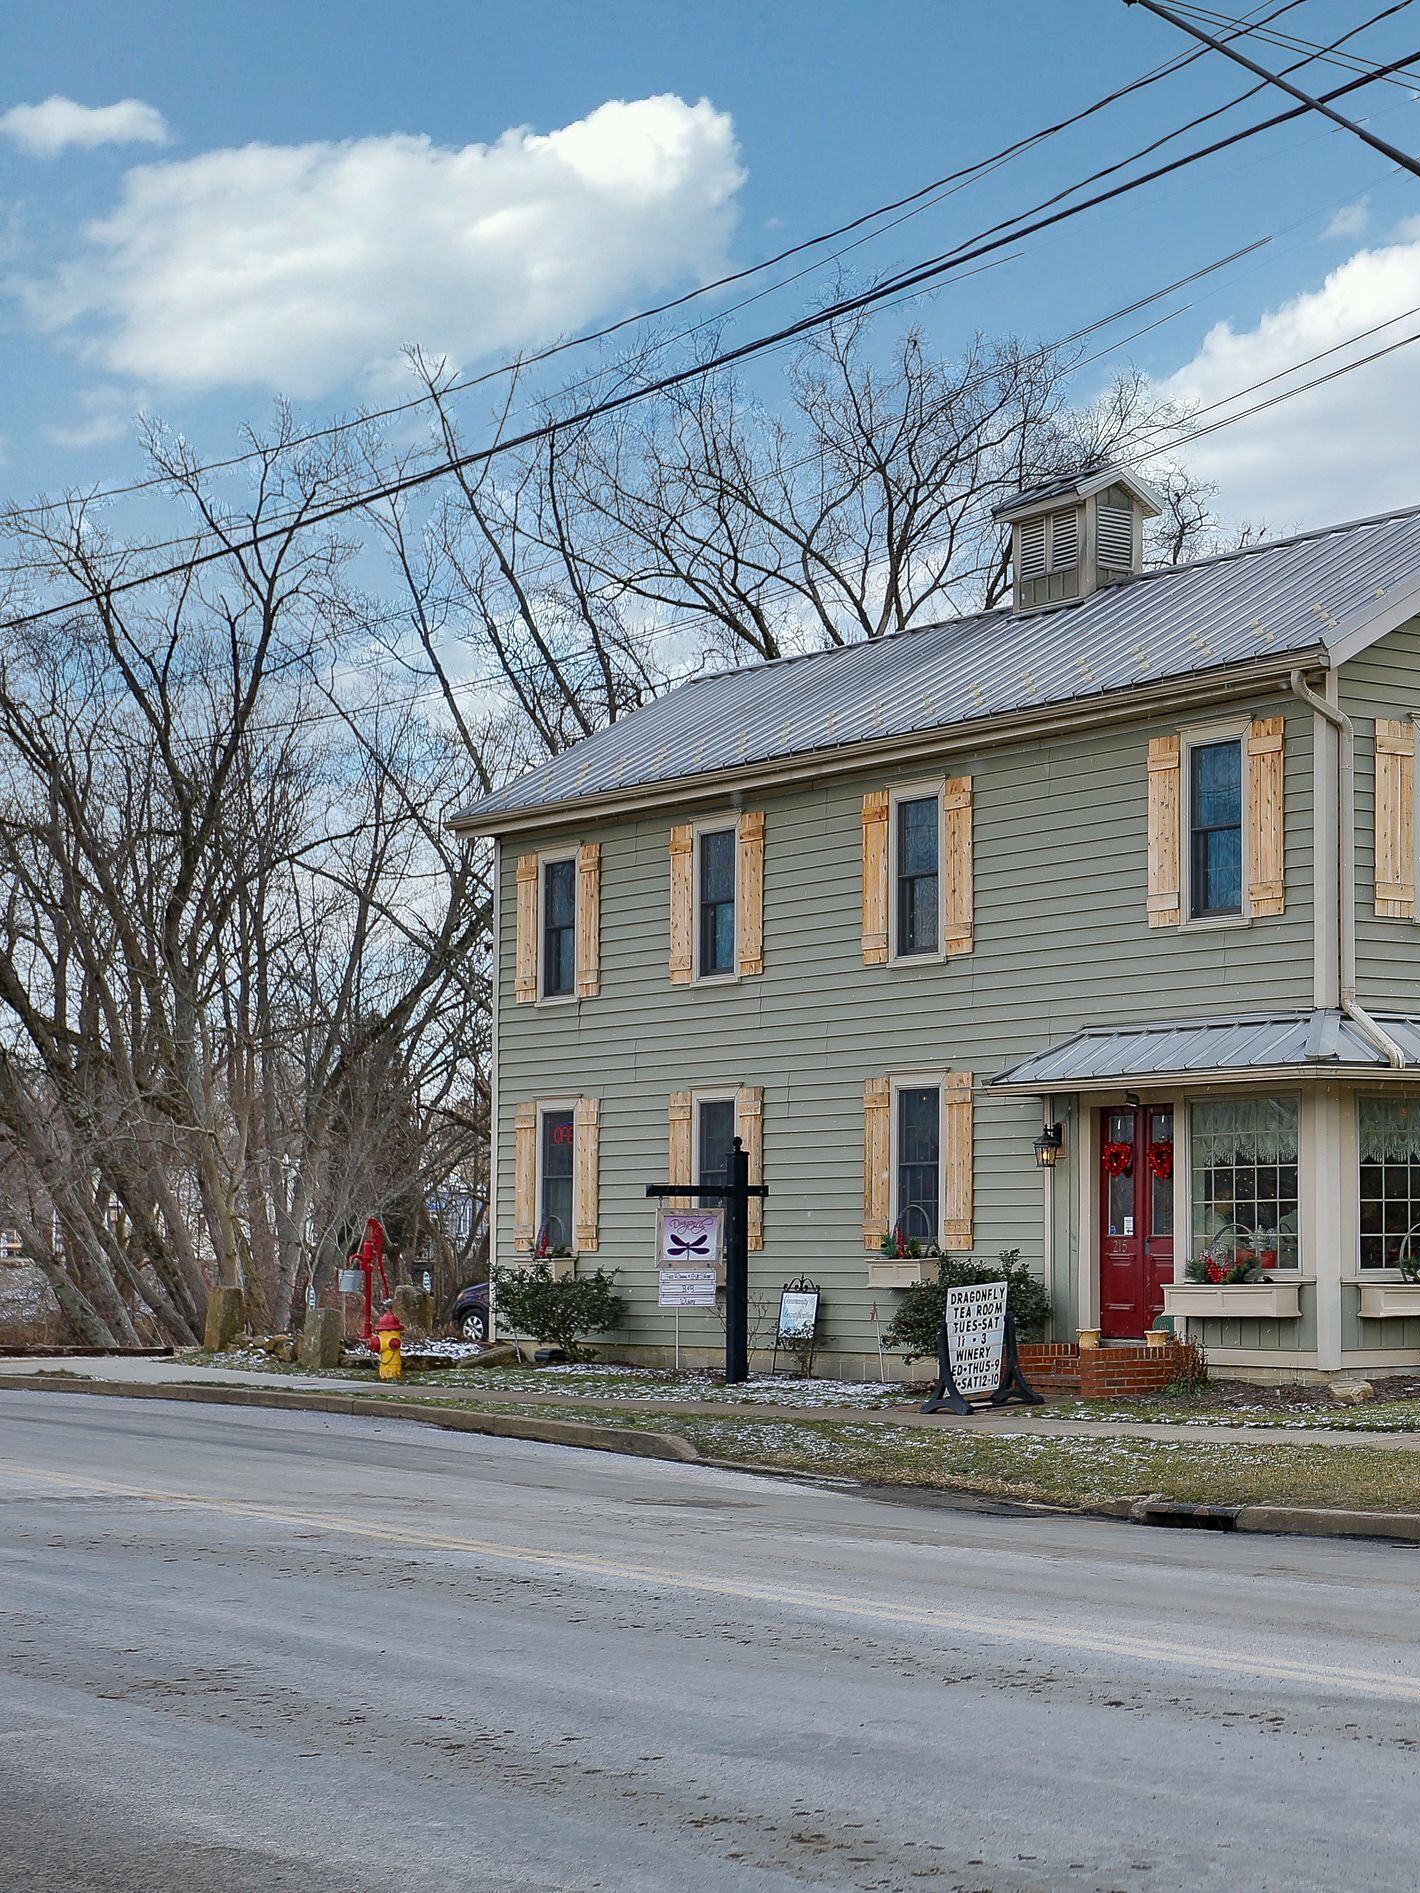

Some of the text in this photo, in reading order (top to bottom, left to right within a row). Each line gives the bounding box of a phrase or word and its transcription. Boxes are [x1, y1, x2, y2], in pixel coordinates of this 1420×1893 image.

[1113, 1240, 1128, 1253] 215
[951, 1287, 1005, 1305] DRAGONFLY
[954, 1302, 1003, 1319] TEA ROOM
[954, 1317, 1000, 1333] TUES-SAT
[981, 1333, 987, 1345] 3
[956, 1346, 991, 1361] WINERY
